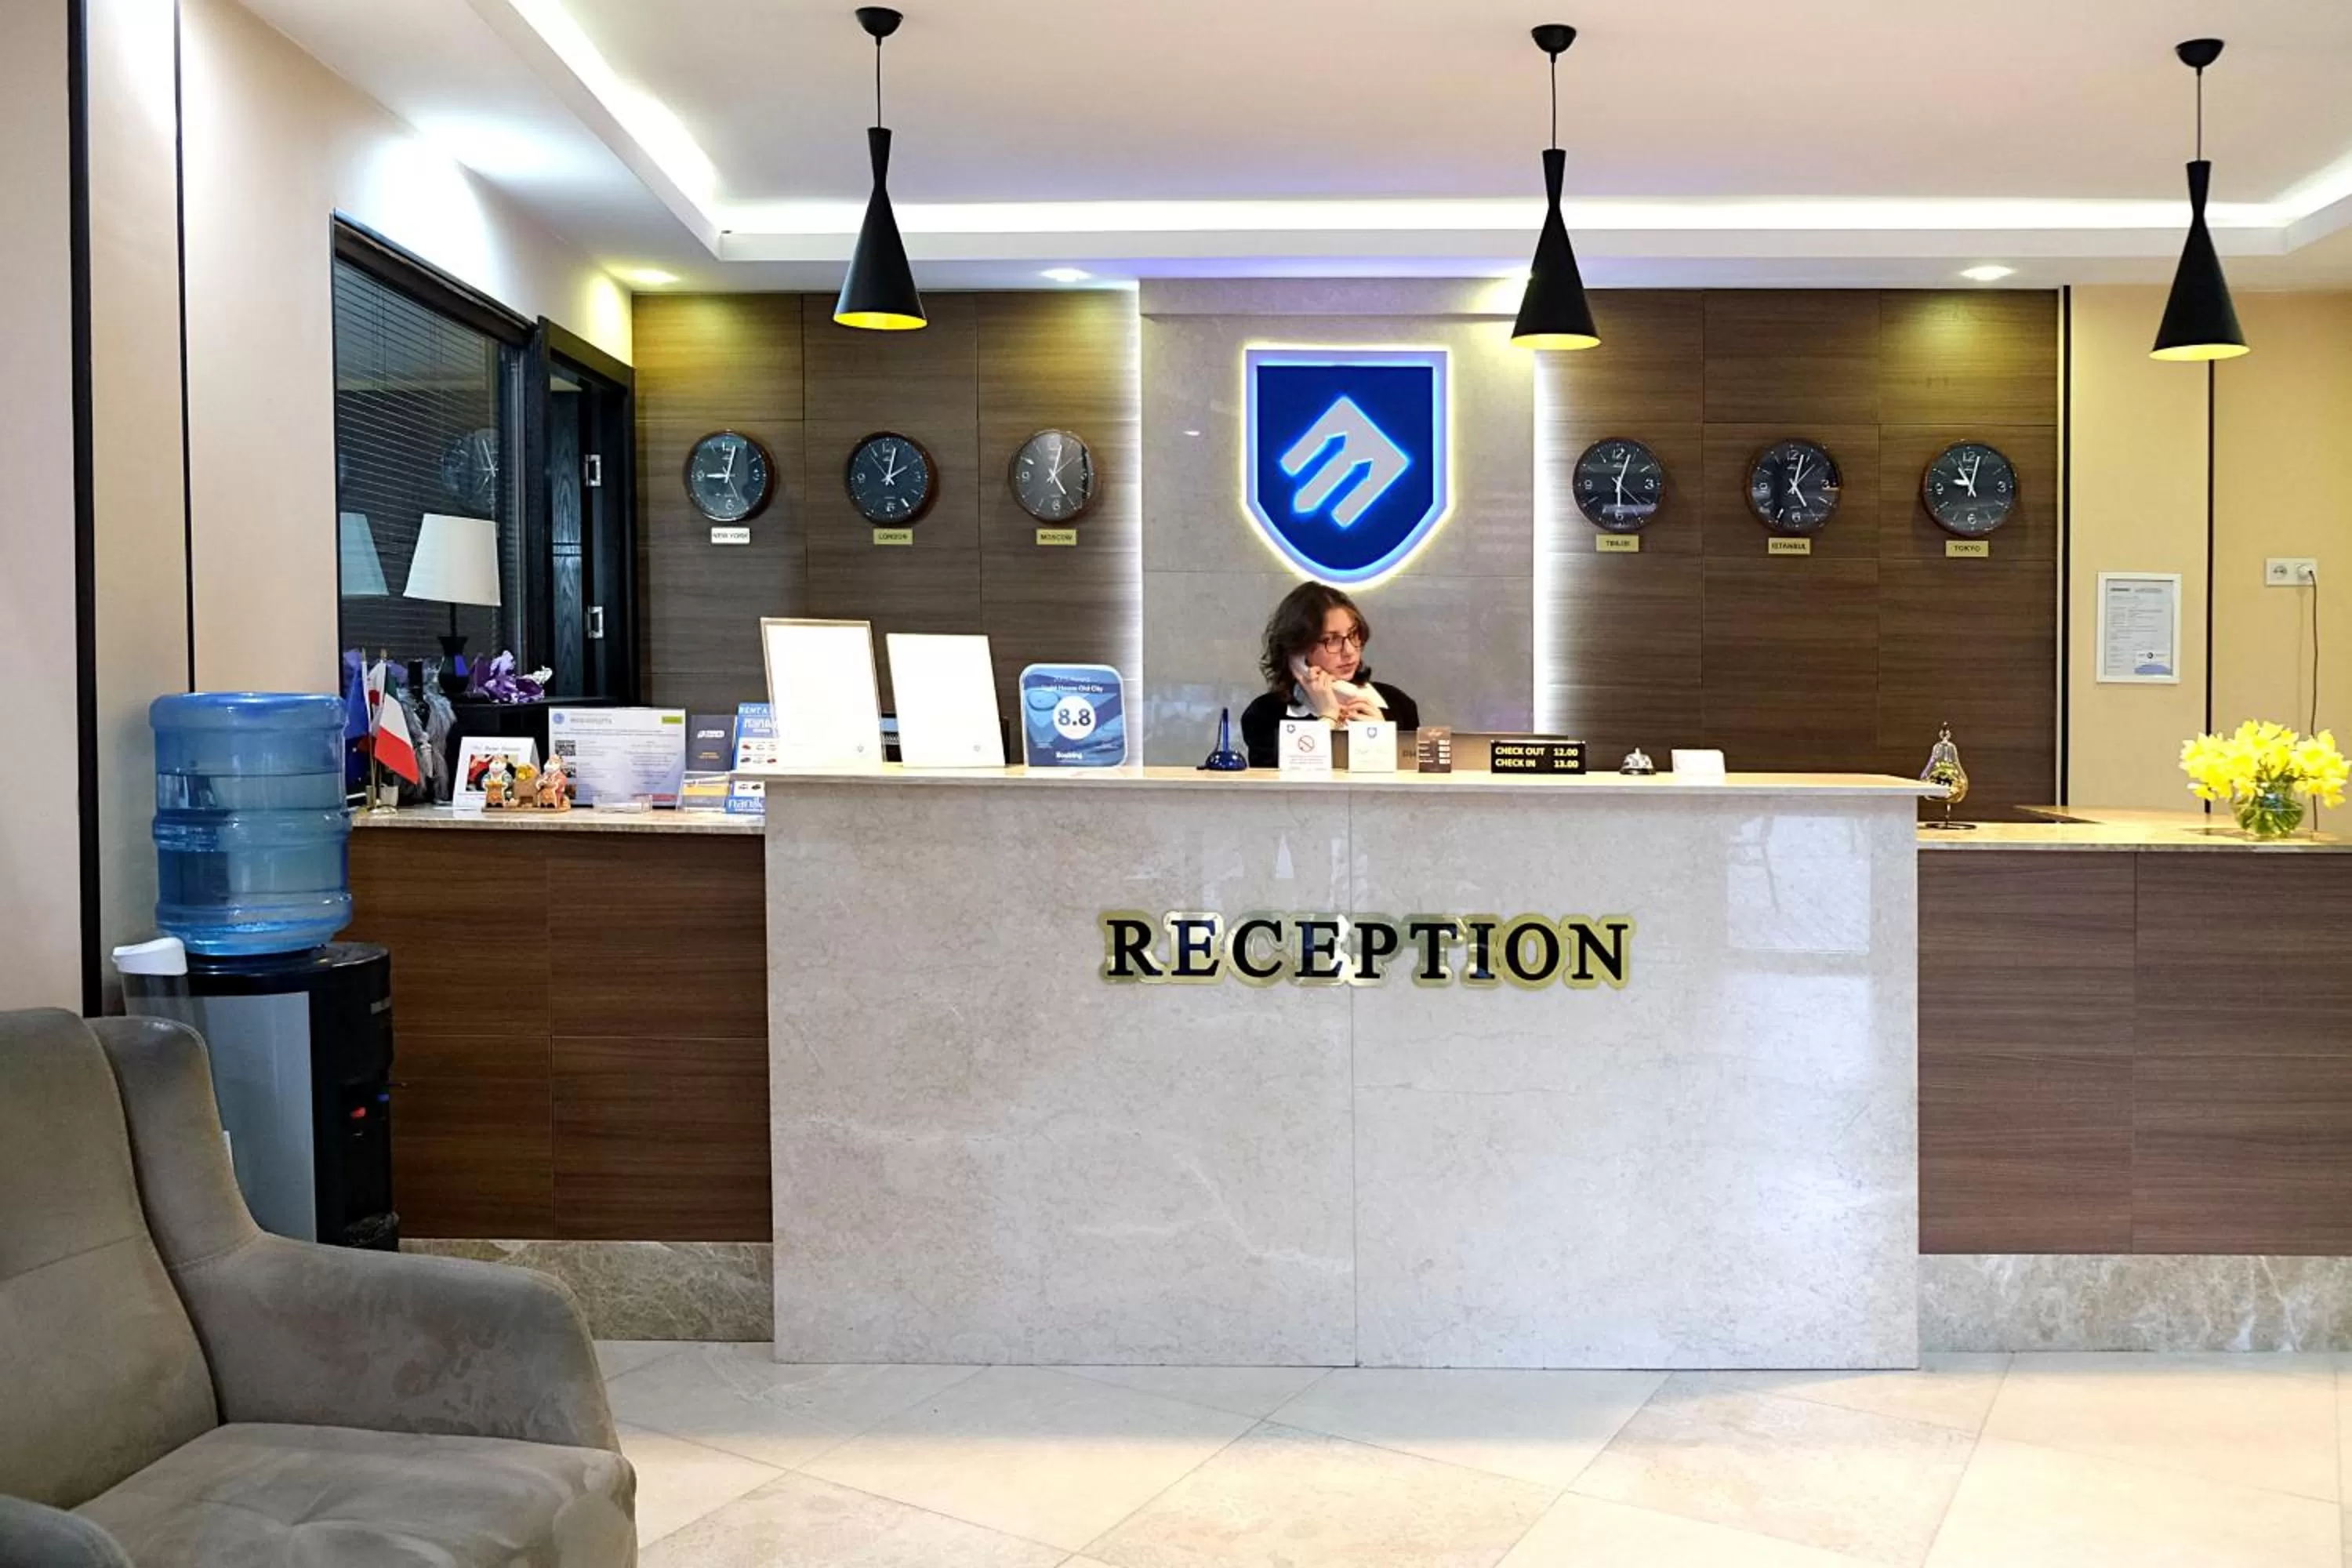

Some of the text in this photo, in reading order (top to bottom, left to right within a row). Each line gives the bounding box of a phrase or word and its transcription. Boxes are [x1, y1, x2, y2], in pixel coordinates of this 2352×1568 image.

[1611, 447, 1625, 459] 12
[1787, 448, 1800, 461] 12
[1962, 450, 1976, 463] 12
[1644, 477, 1655, 491] 3
[1997, 480, 2007, 494] 3
[1967, 513, 1977, 525] 6
[1953, 544, 1982, 553] TOKYO
[1058, 708, 1091, 726] 8.8
[1495, 746, 1578, 757] CHECK OUT 12.00
[1495, 758, 1525, 767] CHECK
[1526, 759, 1537, 768] IN
[1106, 919, 1628, 981] RECEPTION
